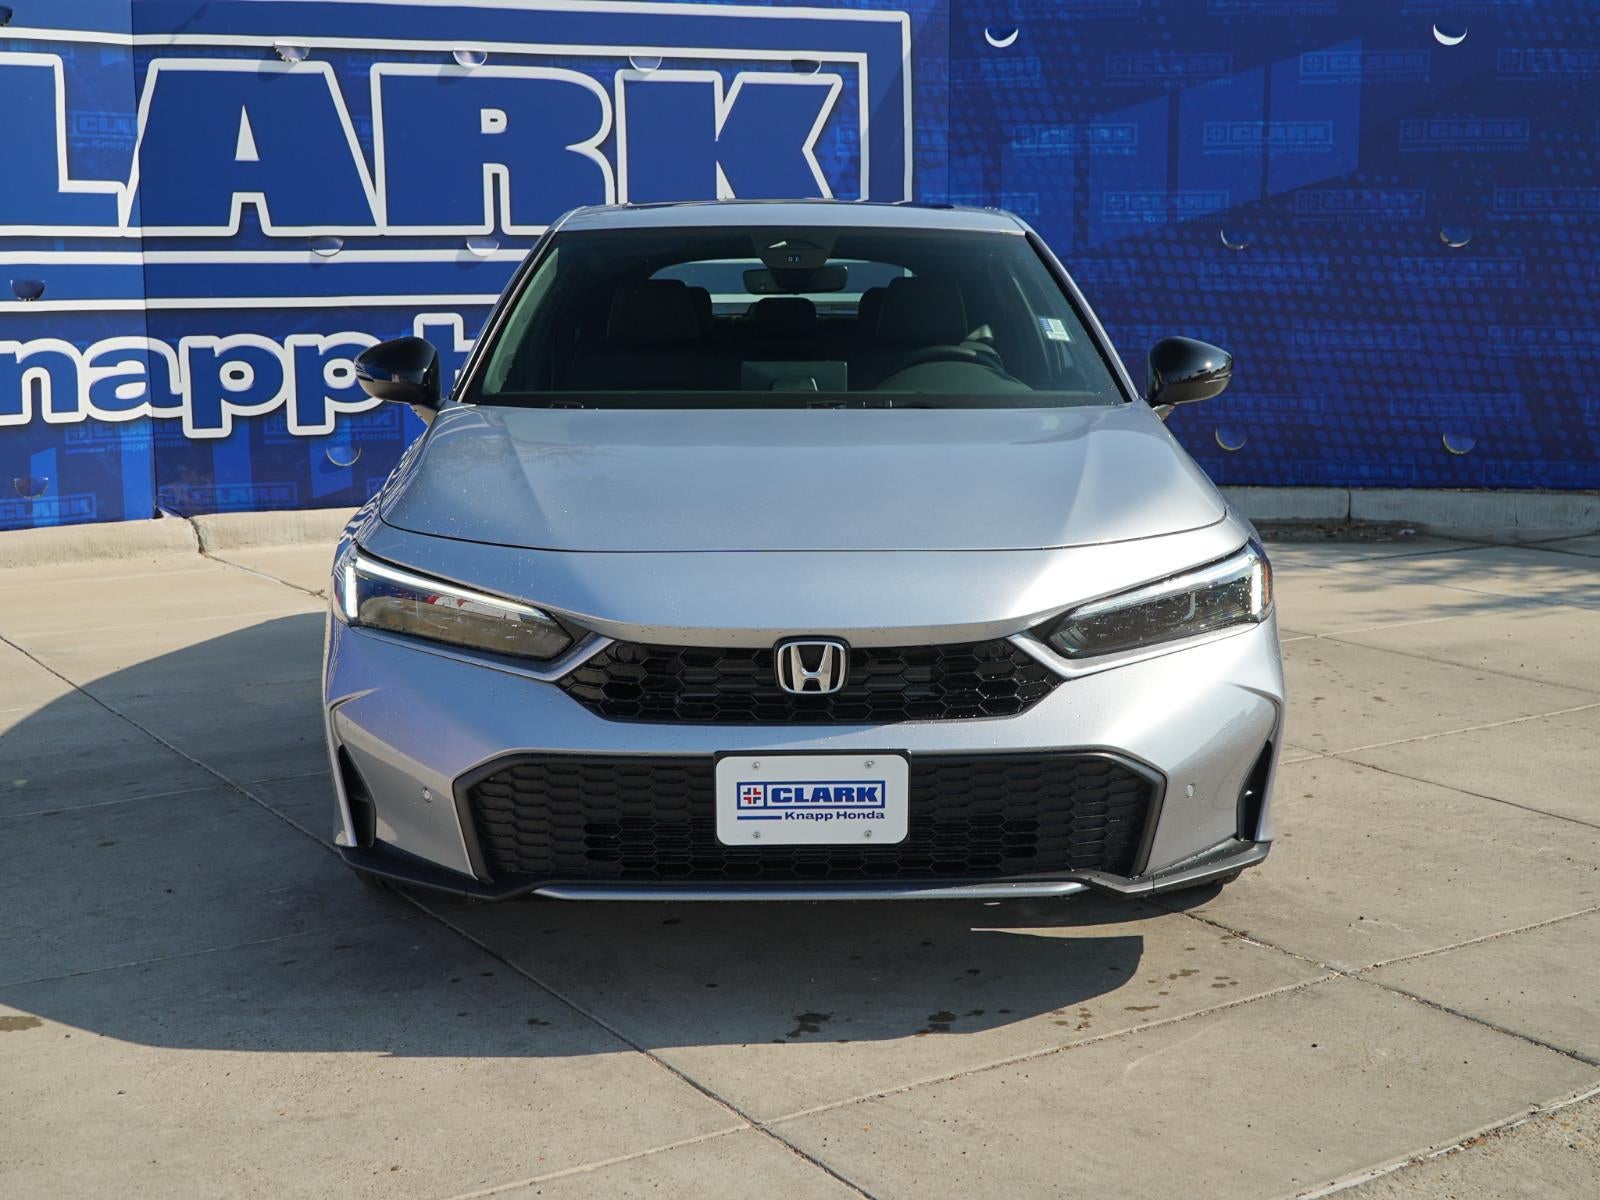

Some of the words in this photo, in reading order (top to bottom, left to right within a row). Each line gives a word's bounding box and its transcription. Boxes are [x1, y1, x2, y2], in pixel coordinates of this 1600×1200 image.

[771, 786, 878, 804] CLARK
[785, 811, 834, 822] Knapp
[836, 810, 885, 820] Honda
